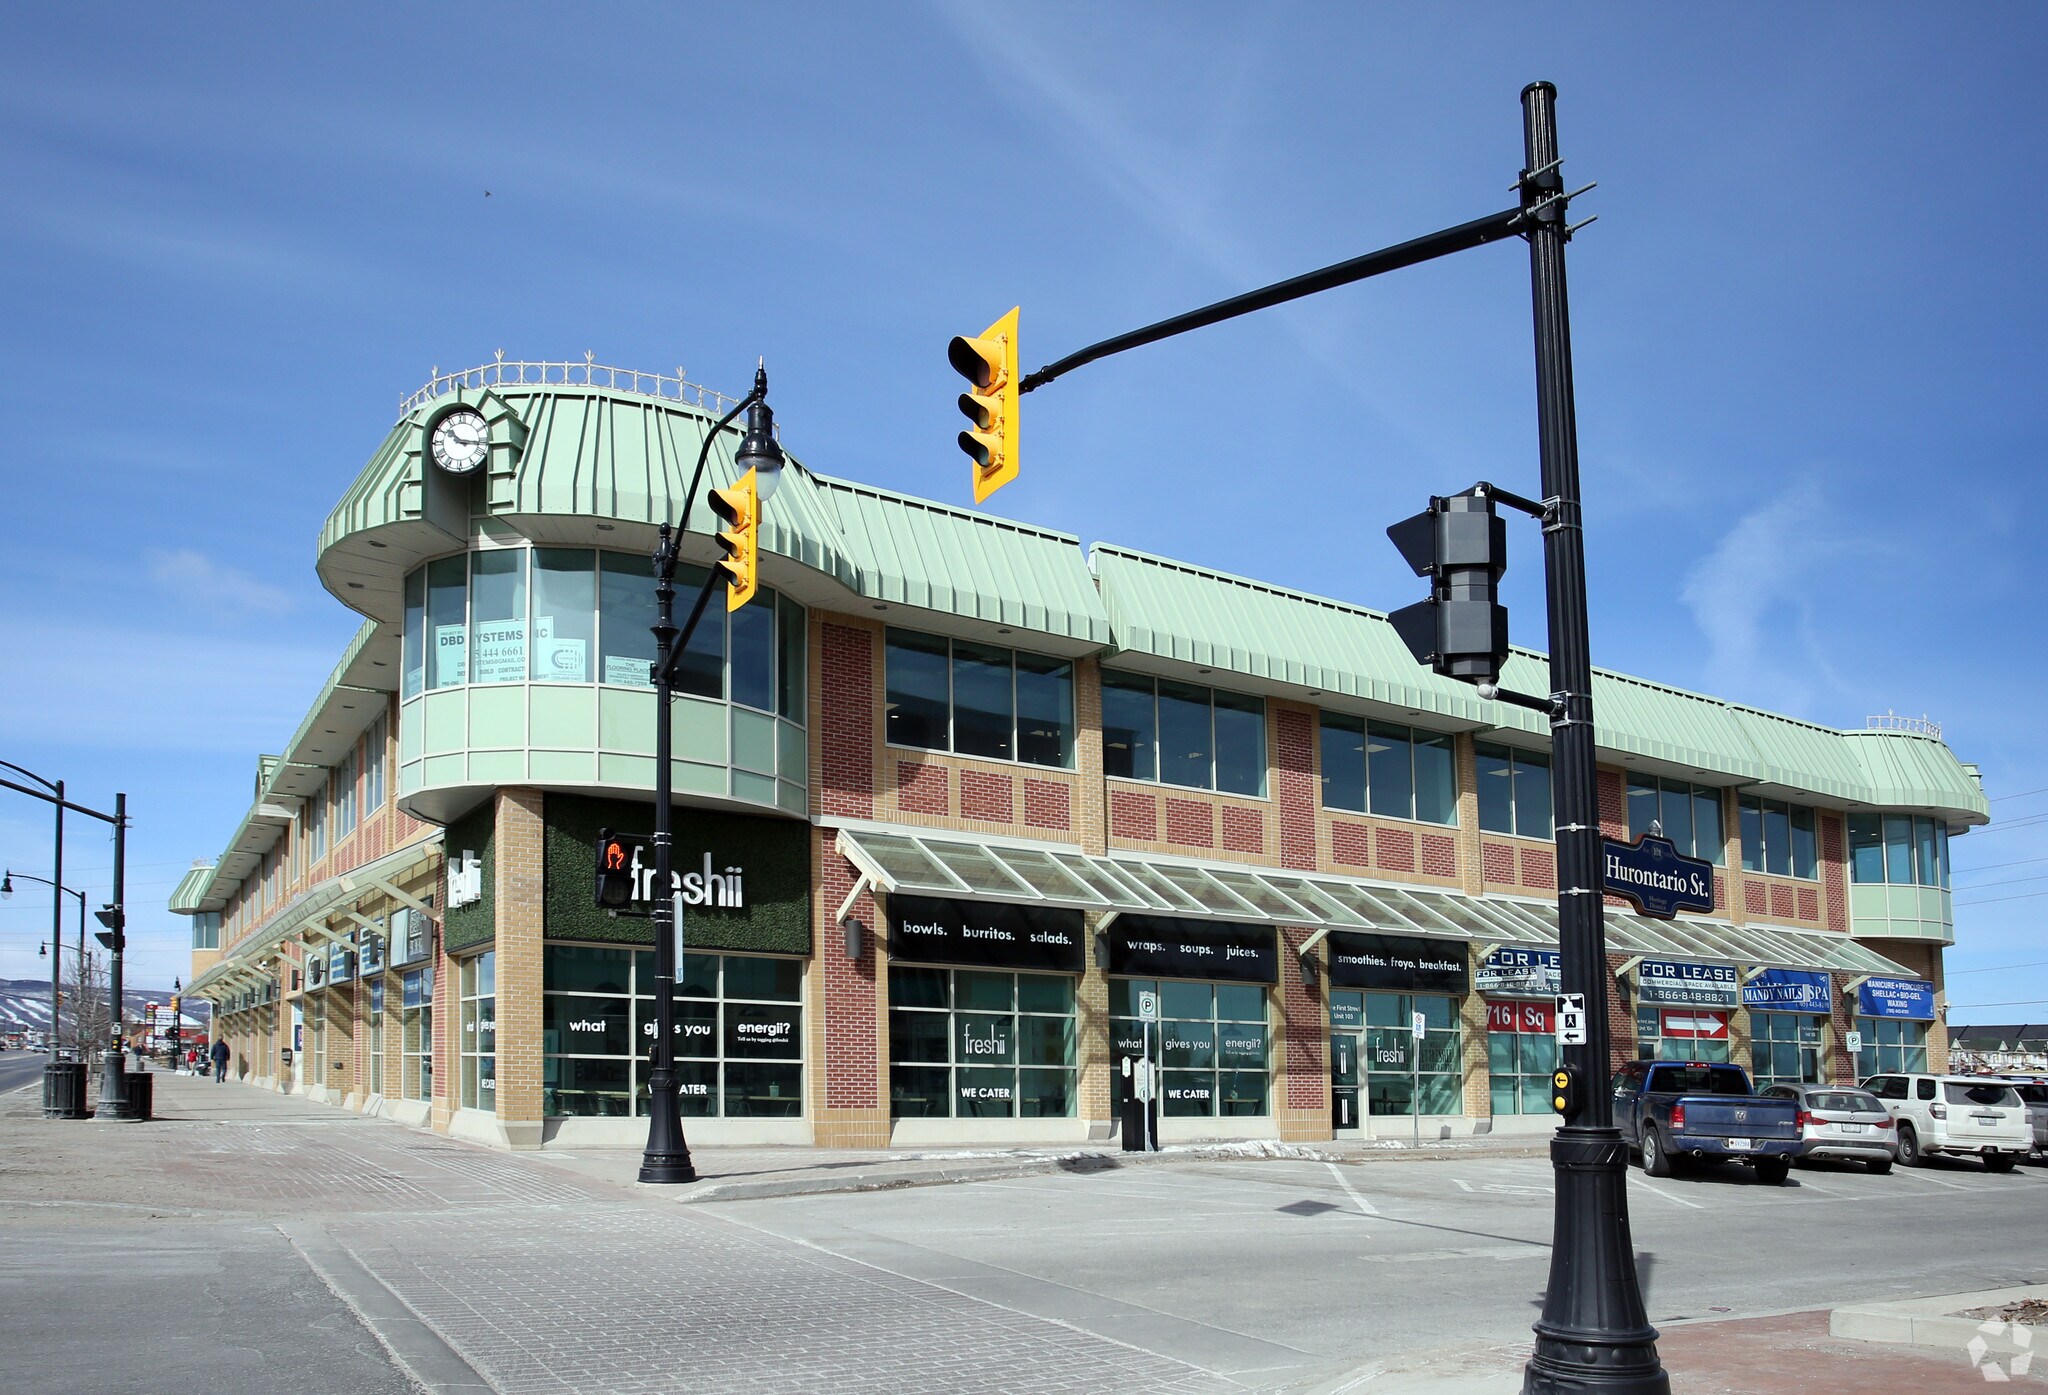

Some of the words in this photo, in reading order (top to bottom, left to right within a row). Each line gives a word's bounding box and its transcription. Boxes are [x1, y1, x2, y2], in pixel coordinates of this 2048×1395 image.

[440, 636, 465, 646] DBD
[475, 630, 524, 643] YSTEMS
[482, 648, 499, 657] 444
[501, 646, 523, 656] 6661
[1606, 854, 1687, 893] Hurontario
[1690, 872, 1709, 898] St.
[903, 920, 948, 936] bowls.
[963, 924, 1016, 941] burritos.
[1030, 931, 1072, 945] salads.
[1127, 941, 1166, 954] wraps.
[1180, 943, 1214, 957] soups.
[1226, 945, 1259, 961] juices.
[1338, 954, 1387, 967] smoothies.
[1391, 957, 1416, 971] froyo.
[1419, 958, 1462, 972] breakfast.
[1476, 970, 1498, 978] FOR
[1501, 968, 1537, 976] LEASE
[1642, 963, 1676, 977] FOR
[1682, 966, 1734, 981] LEASE
[1643, 978, 1682, 987] COMMERCIAL
[1704, 982, 1735, 990] AVAILABLE
[1867, 980, 1895, 990] MANICURE
[1899, 982, 1925, 992] PEDICURE
[1744, 987, 1775, 1002] MANDY
[1777, 987, 1803, 1000] NAILS
[1809, 986, 1829, 1001] SPA
[1871, 989, 1897, 998] SHELLAC
[1900, 991, 1922, 1000] BIO-GEL
[1887, 1000, 1908, 1008] WAXING
[1525, 1007, 1545, 1031] Sq
[569, 1019, 606, 1032] what
[644, 1019, 681, 1039] gis
[684, 1025, 711, 1037] you
[737, 1022, 791, 1036] energii?
[964, 1023, 1006, 1055] freshii
[1117, 1038, 1143, 1049] what
[1165, 1039, 1191, 1051] gives
[1193, 1041, 1210, 1051] you
[1225, 1038, 1261, 1050] energii?
[1376, 1037, 1405, 1064] freshii
[679, 1084, 707, 1095] ATER
[961, 1088, 976, 1098] WE
[978, 1087, 1011, 1099] CATER
[1168, 1089, 1182, 1099] WE
[1183, 1089, 1210, 1099] CATER
